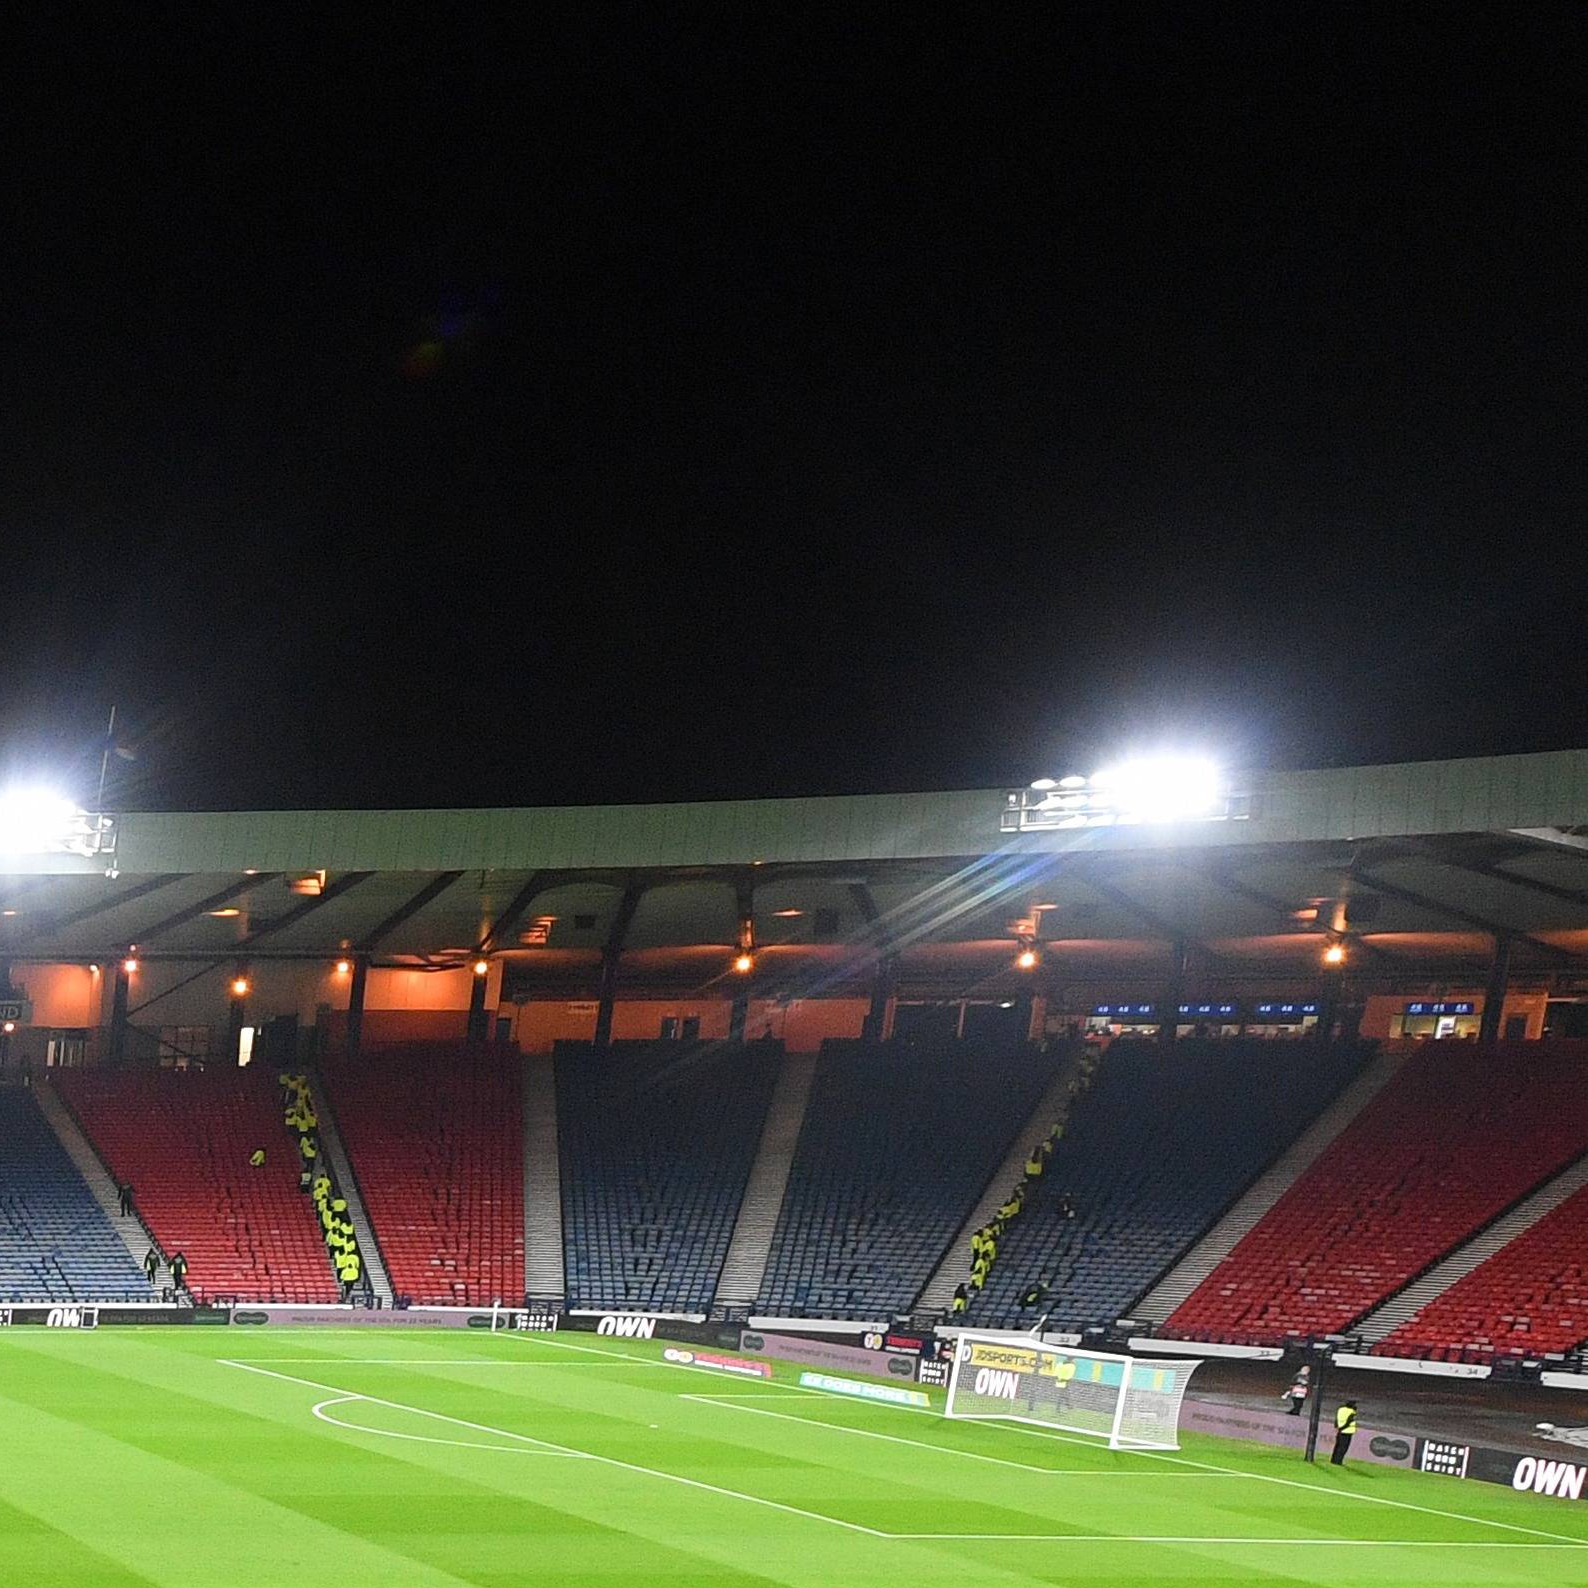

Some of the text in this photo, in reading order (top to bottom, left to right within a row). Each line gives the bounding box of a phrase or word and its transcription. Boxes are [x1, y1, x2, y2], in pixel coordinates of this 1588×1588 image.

[597, 1316, 656, 1339] OWN
[975, 1367, 1020, 1399] OWN
[1512, 1457, 1588, 1500] OWN
